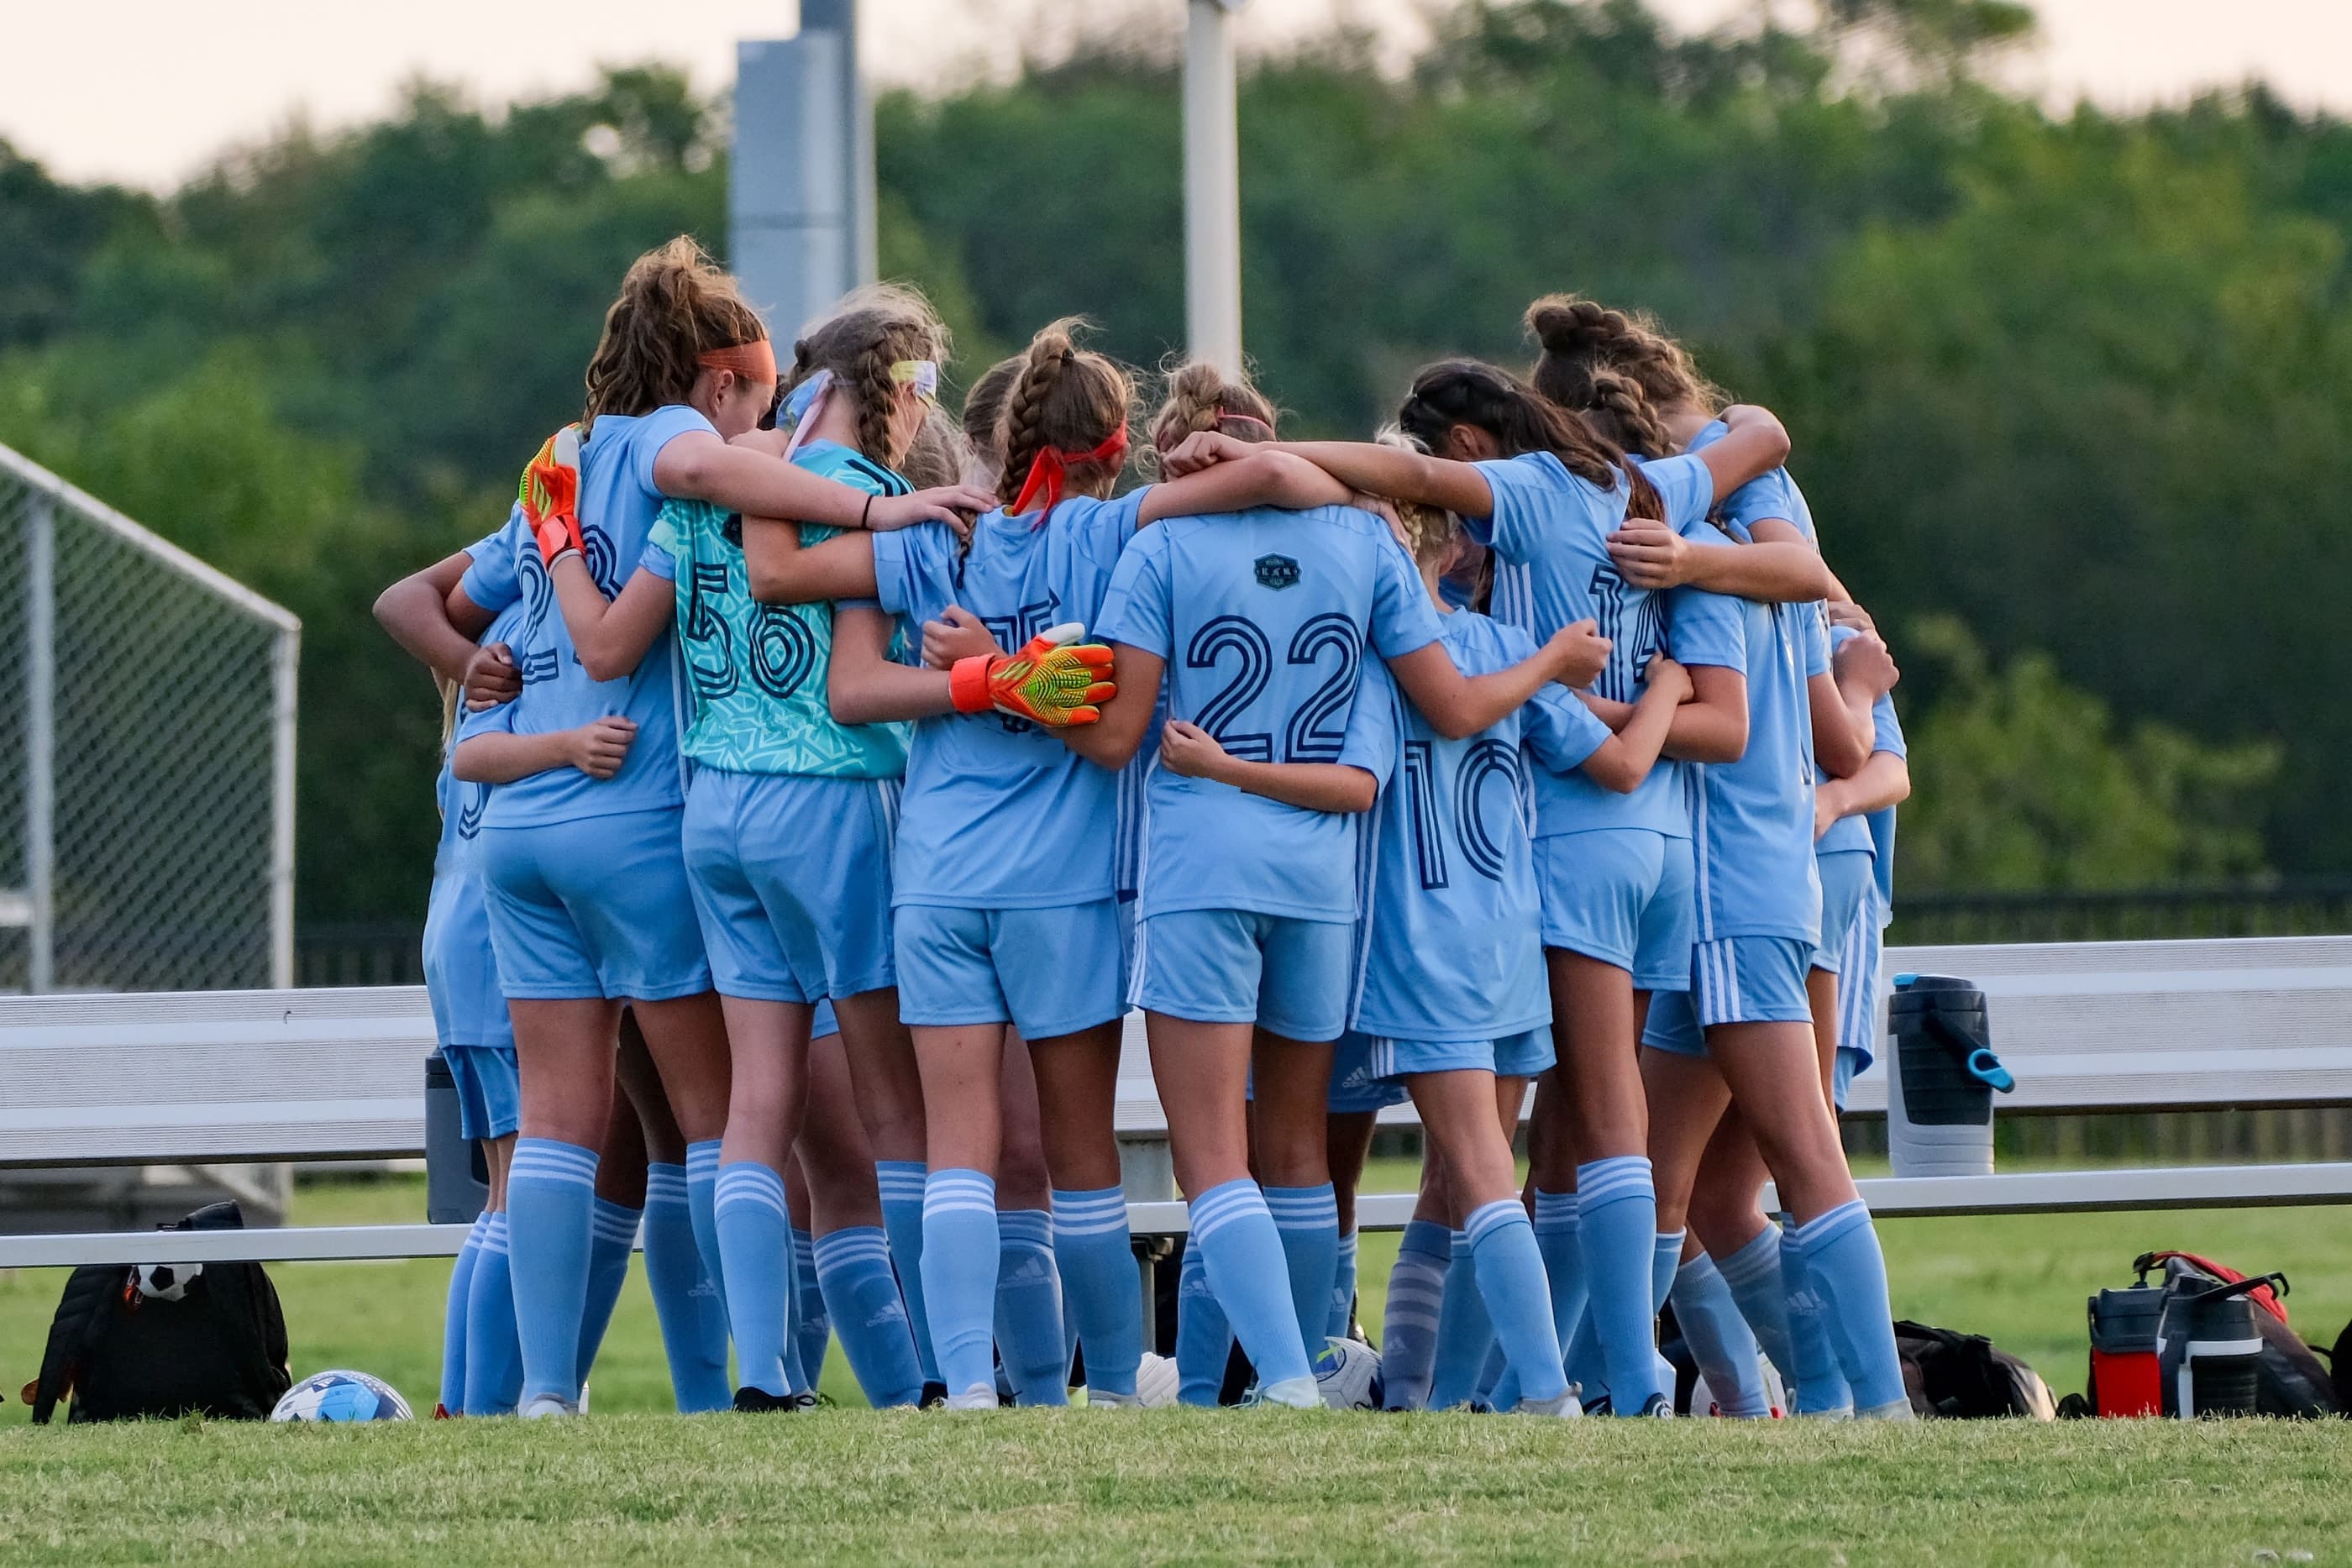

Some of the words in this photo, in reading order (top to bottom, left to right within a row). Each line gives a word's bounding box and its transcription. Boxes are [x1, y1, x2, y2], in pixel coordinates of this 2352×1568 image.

[686, 562, 816, 700] 56
[1187, 612, 1363, 763] 22
[1404, 739, 1520, 890] 10
